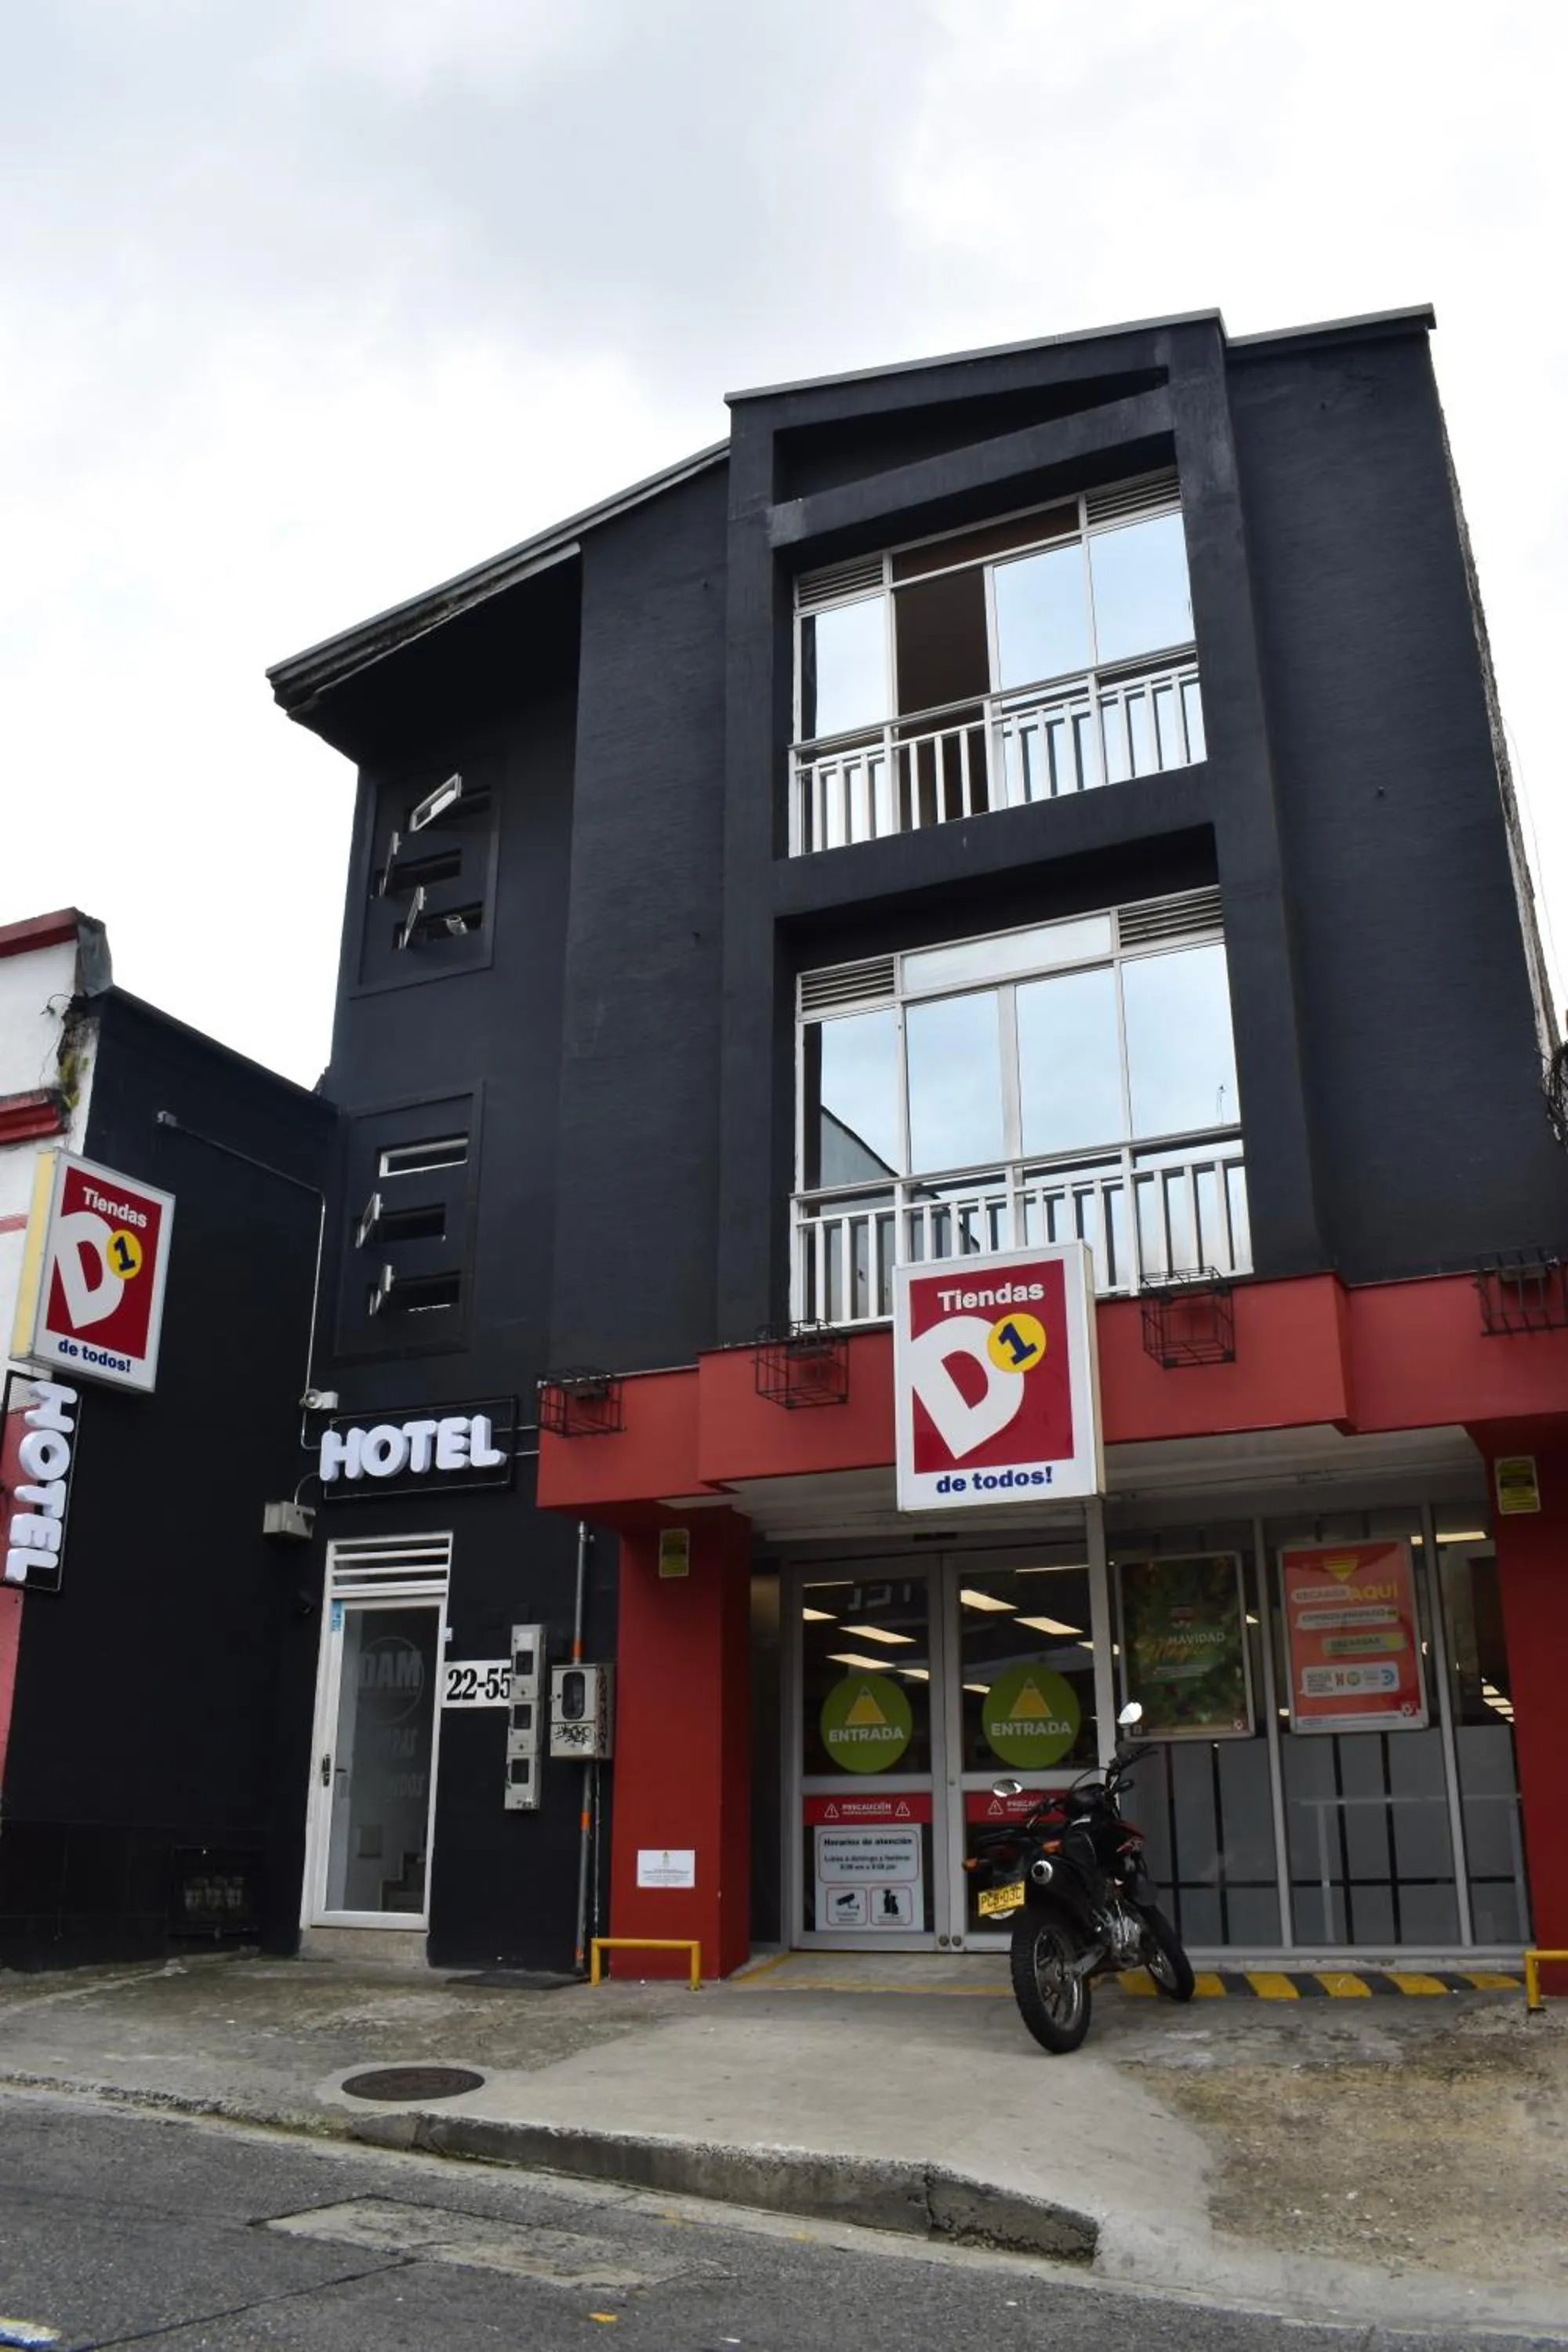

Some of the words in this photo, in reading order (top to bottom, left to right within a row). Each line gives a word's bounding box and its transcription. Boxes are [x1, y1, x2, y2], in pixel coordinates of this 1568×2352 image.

[82, 1187, 147, 1229] Tiendas
[938, 1283, 1044, 1312] Tiendas
[58, 1338, 78, 1357] de
[83, 1345, 131, 1373] todos!
[319, 1414, 507, 1482] HOTEL
[5, 1380, 78, 1583] HOTEL
[936, 1475, 967, 1494] de
[972, 1466, 1053, 1487] todos!
[447, 1668, 511, 1700] 22-55
[828, 1726, 905, 1743] ENTRADA
[990, 1722, 1073, 1737] ENTRADA
